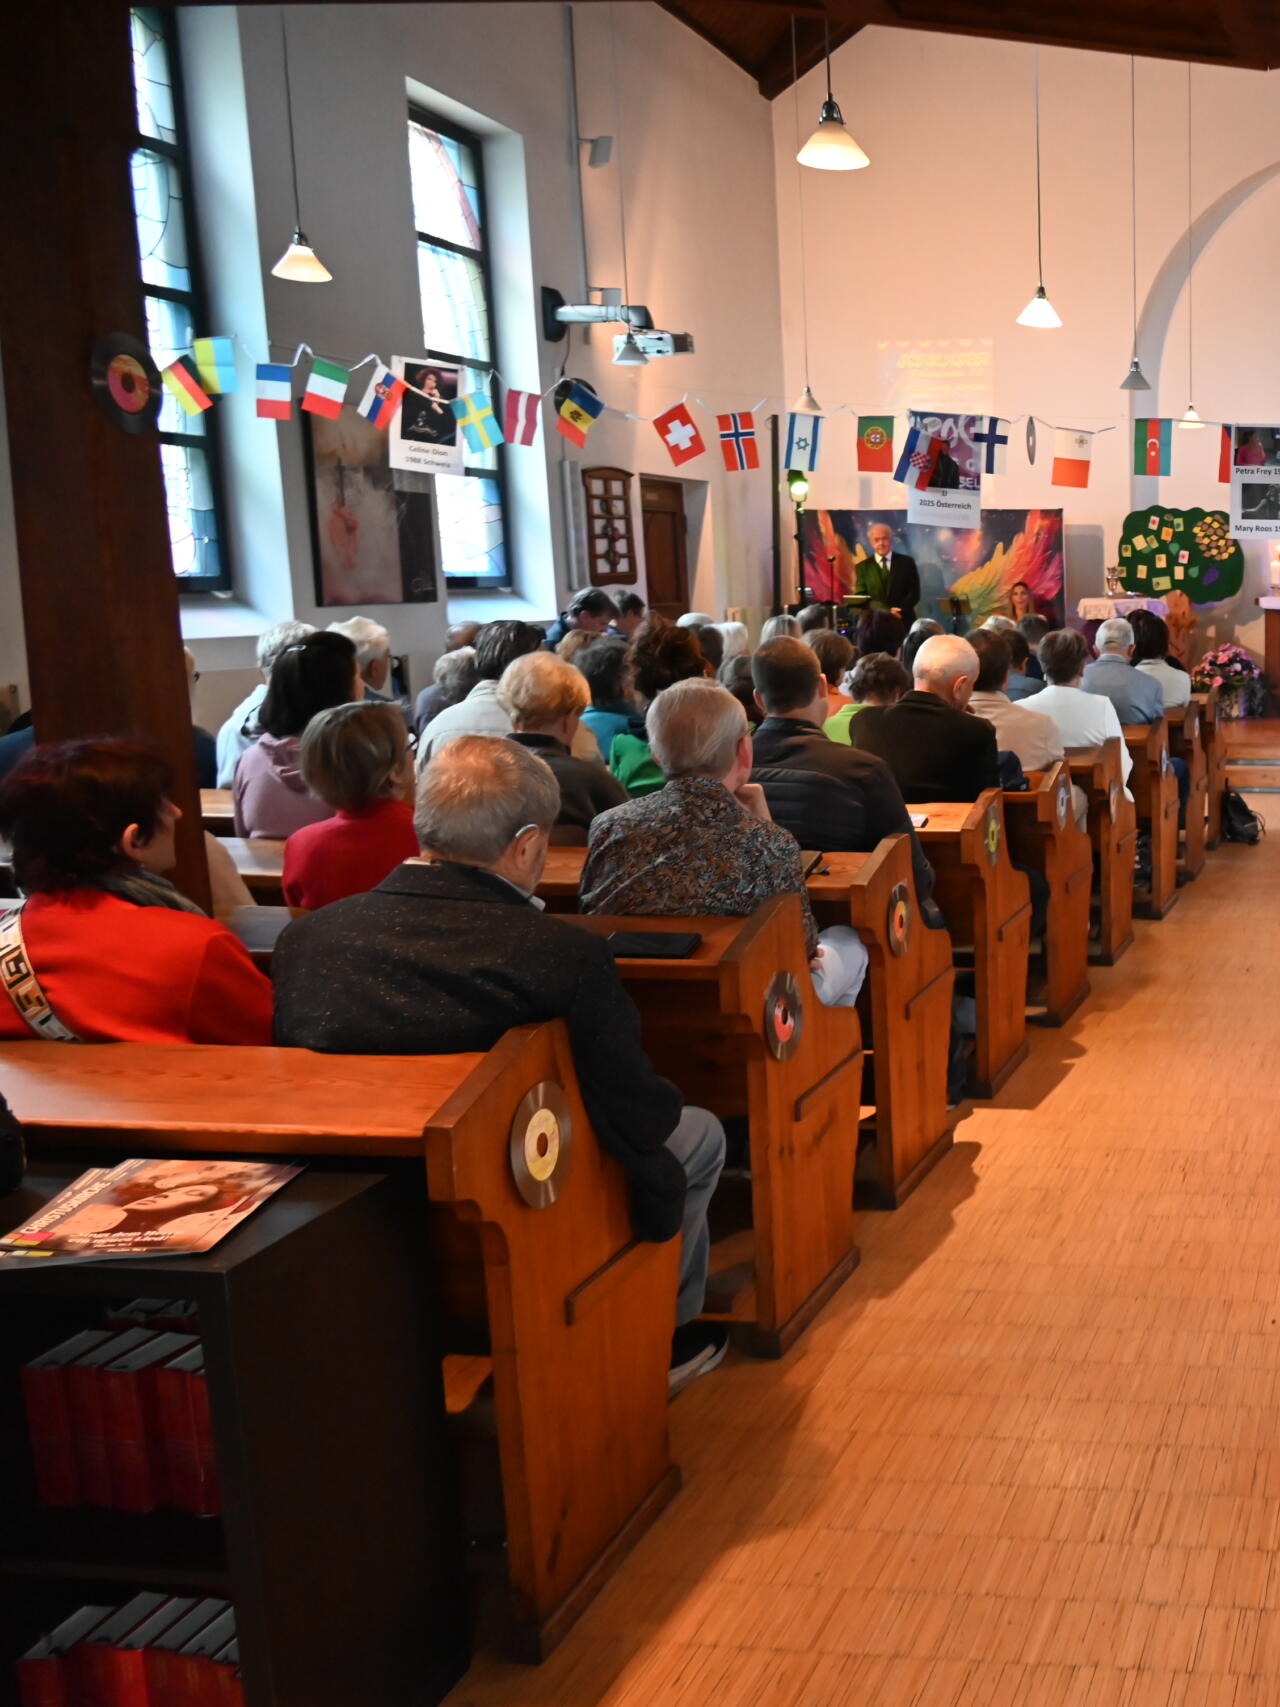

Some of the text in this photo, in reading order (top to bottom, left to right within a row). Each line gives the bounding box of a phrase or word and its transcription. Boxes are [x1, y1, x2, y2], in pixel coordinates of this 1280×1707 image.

[432, 448, 449, 456] Dion
[1256, 468, 1271, 476] Frey
[919, 499, 972, 510] 2025 Österreich
[1235, 525, 1254, 533] Mary
